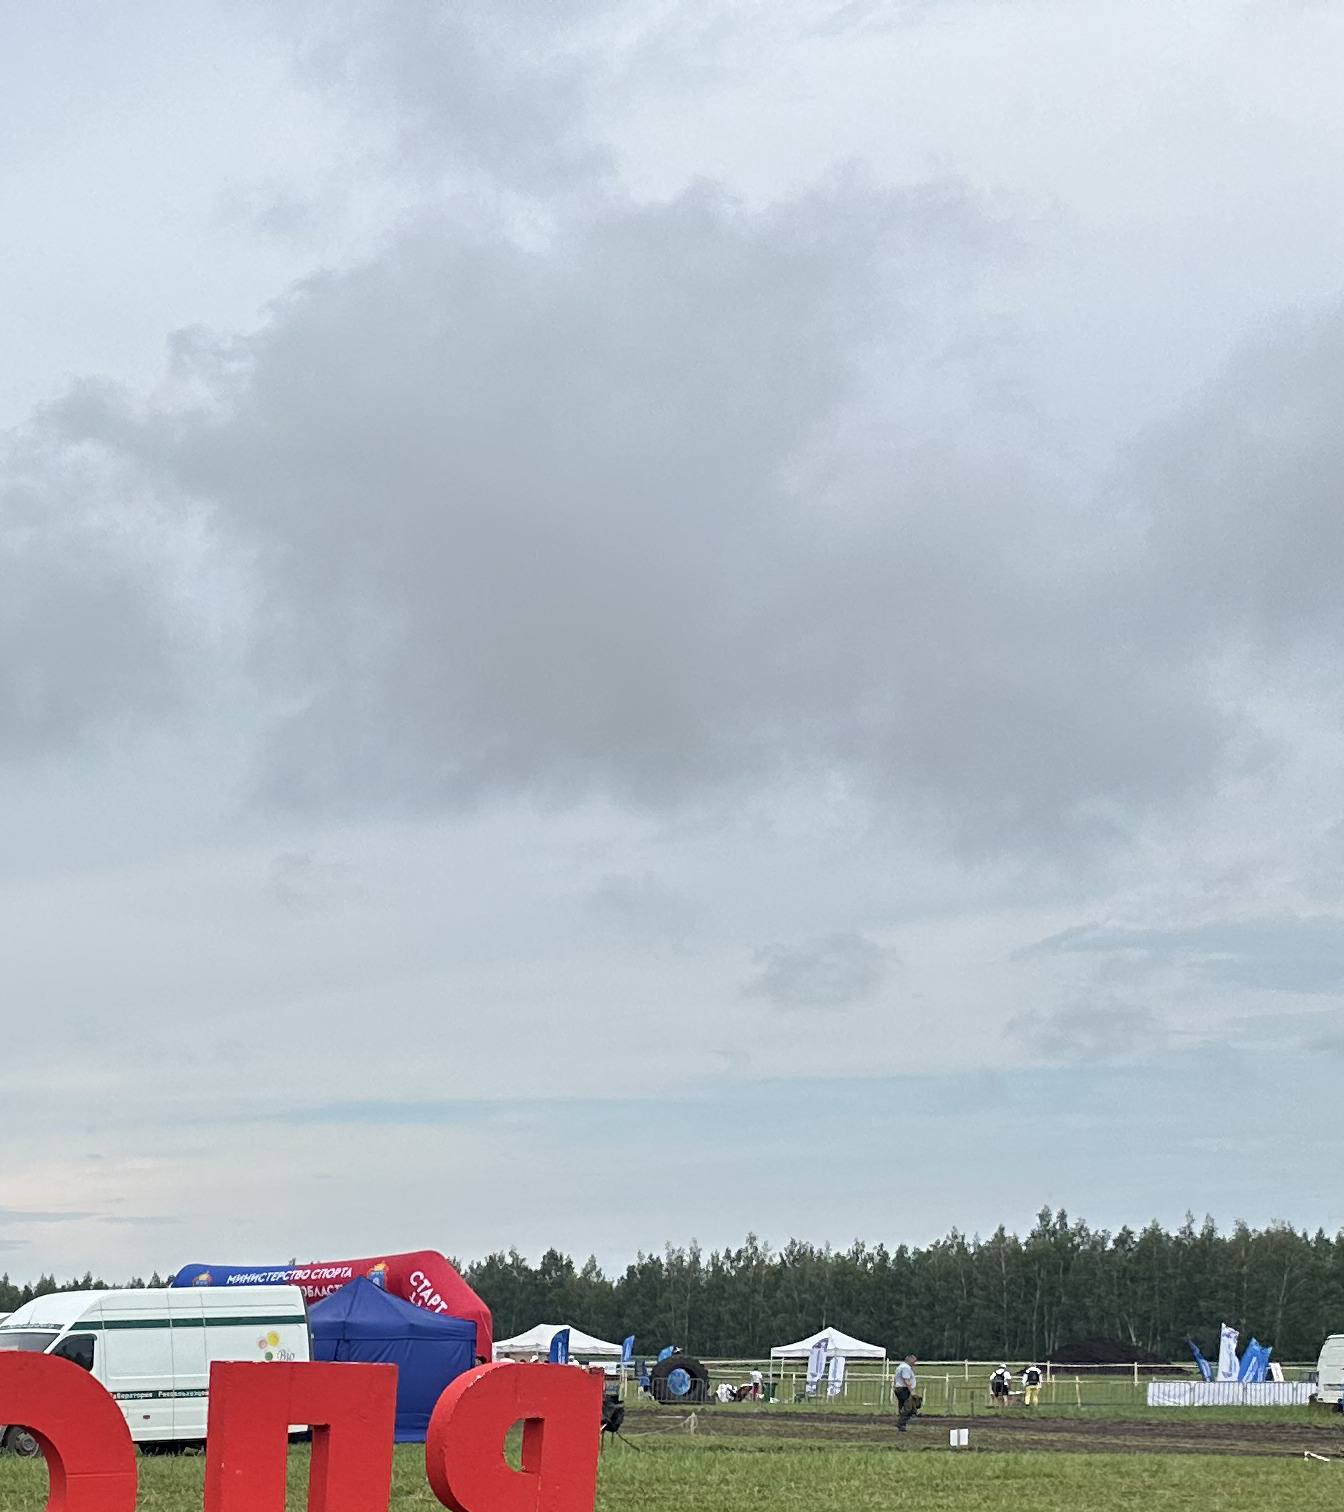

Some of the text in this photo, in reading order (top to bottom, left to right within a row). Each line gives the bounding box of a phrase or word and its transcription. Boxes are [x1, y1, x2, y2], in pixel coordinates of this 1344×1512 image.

[226, 1267, 352, 1285] МИНИСТЕРСТВО СПОРТА
[409, 1271, 448, 1314] СТАРТ
